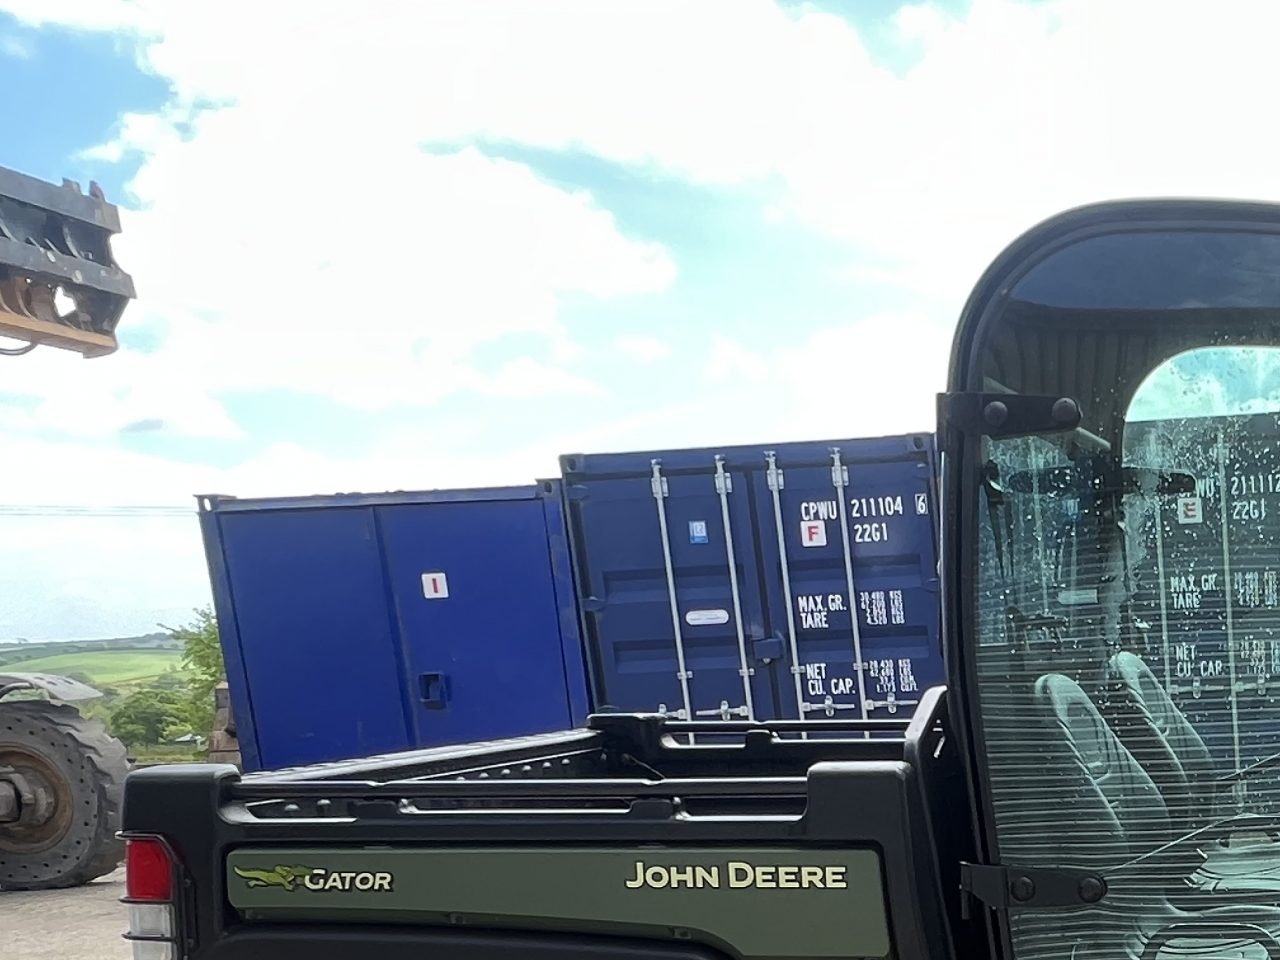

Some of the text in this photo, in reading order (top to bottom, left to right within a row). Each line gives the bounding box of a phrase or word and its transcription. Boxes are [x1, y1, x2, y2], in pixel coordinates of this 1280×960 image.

[801, 500, 838, 520] CPWU
[850, 496, 903, 517] 211104
[1183, 501, 1197, 519] E
[807, 526, 819, 541] F
[853, 523, 888, 542] 22G1
[828, 594, 847, 611] GR.
[800, 612, 829, 629] TARE
[806, 664, 826, 679] NET
[808, 679, 856, 695] CU. CAP.
[304, 868, 393, 891] GATOR
[625, 862, 848, 889] JOHN DEERE
